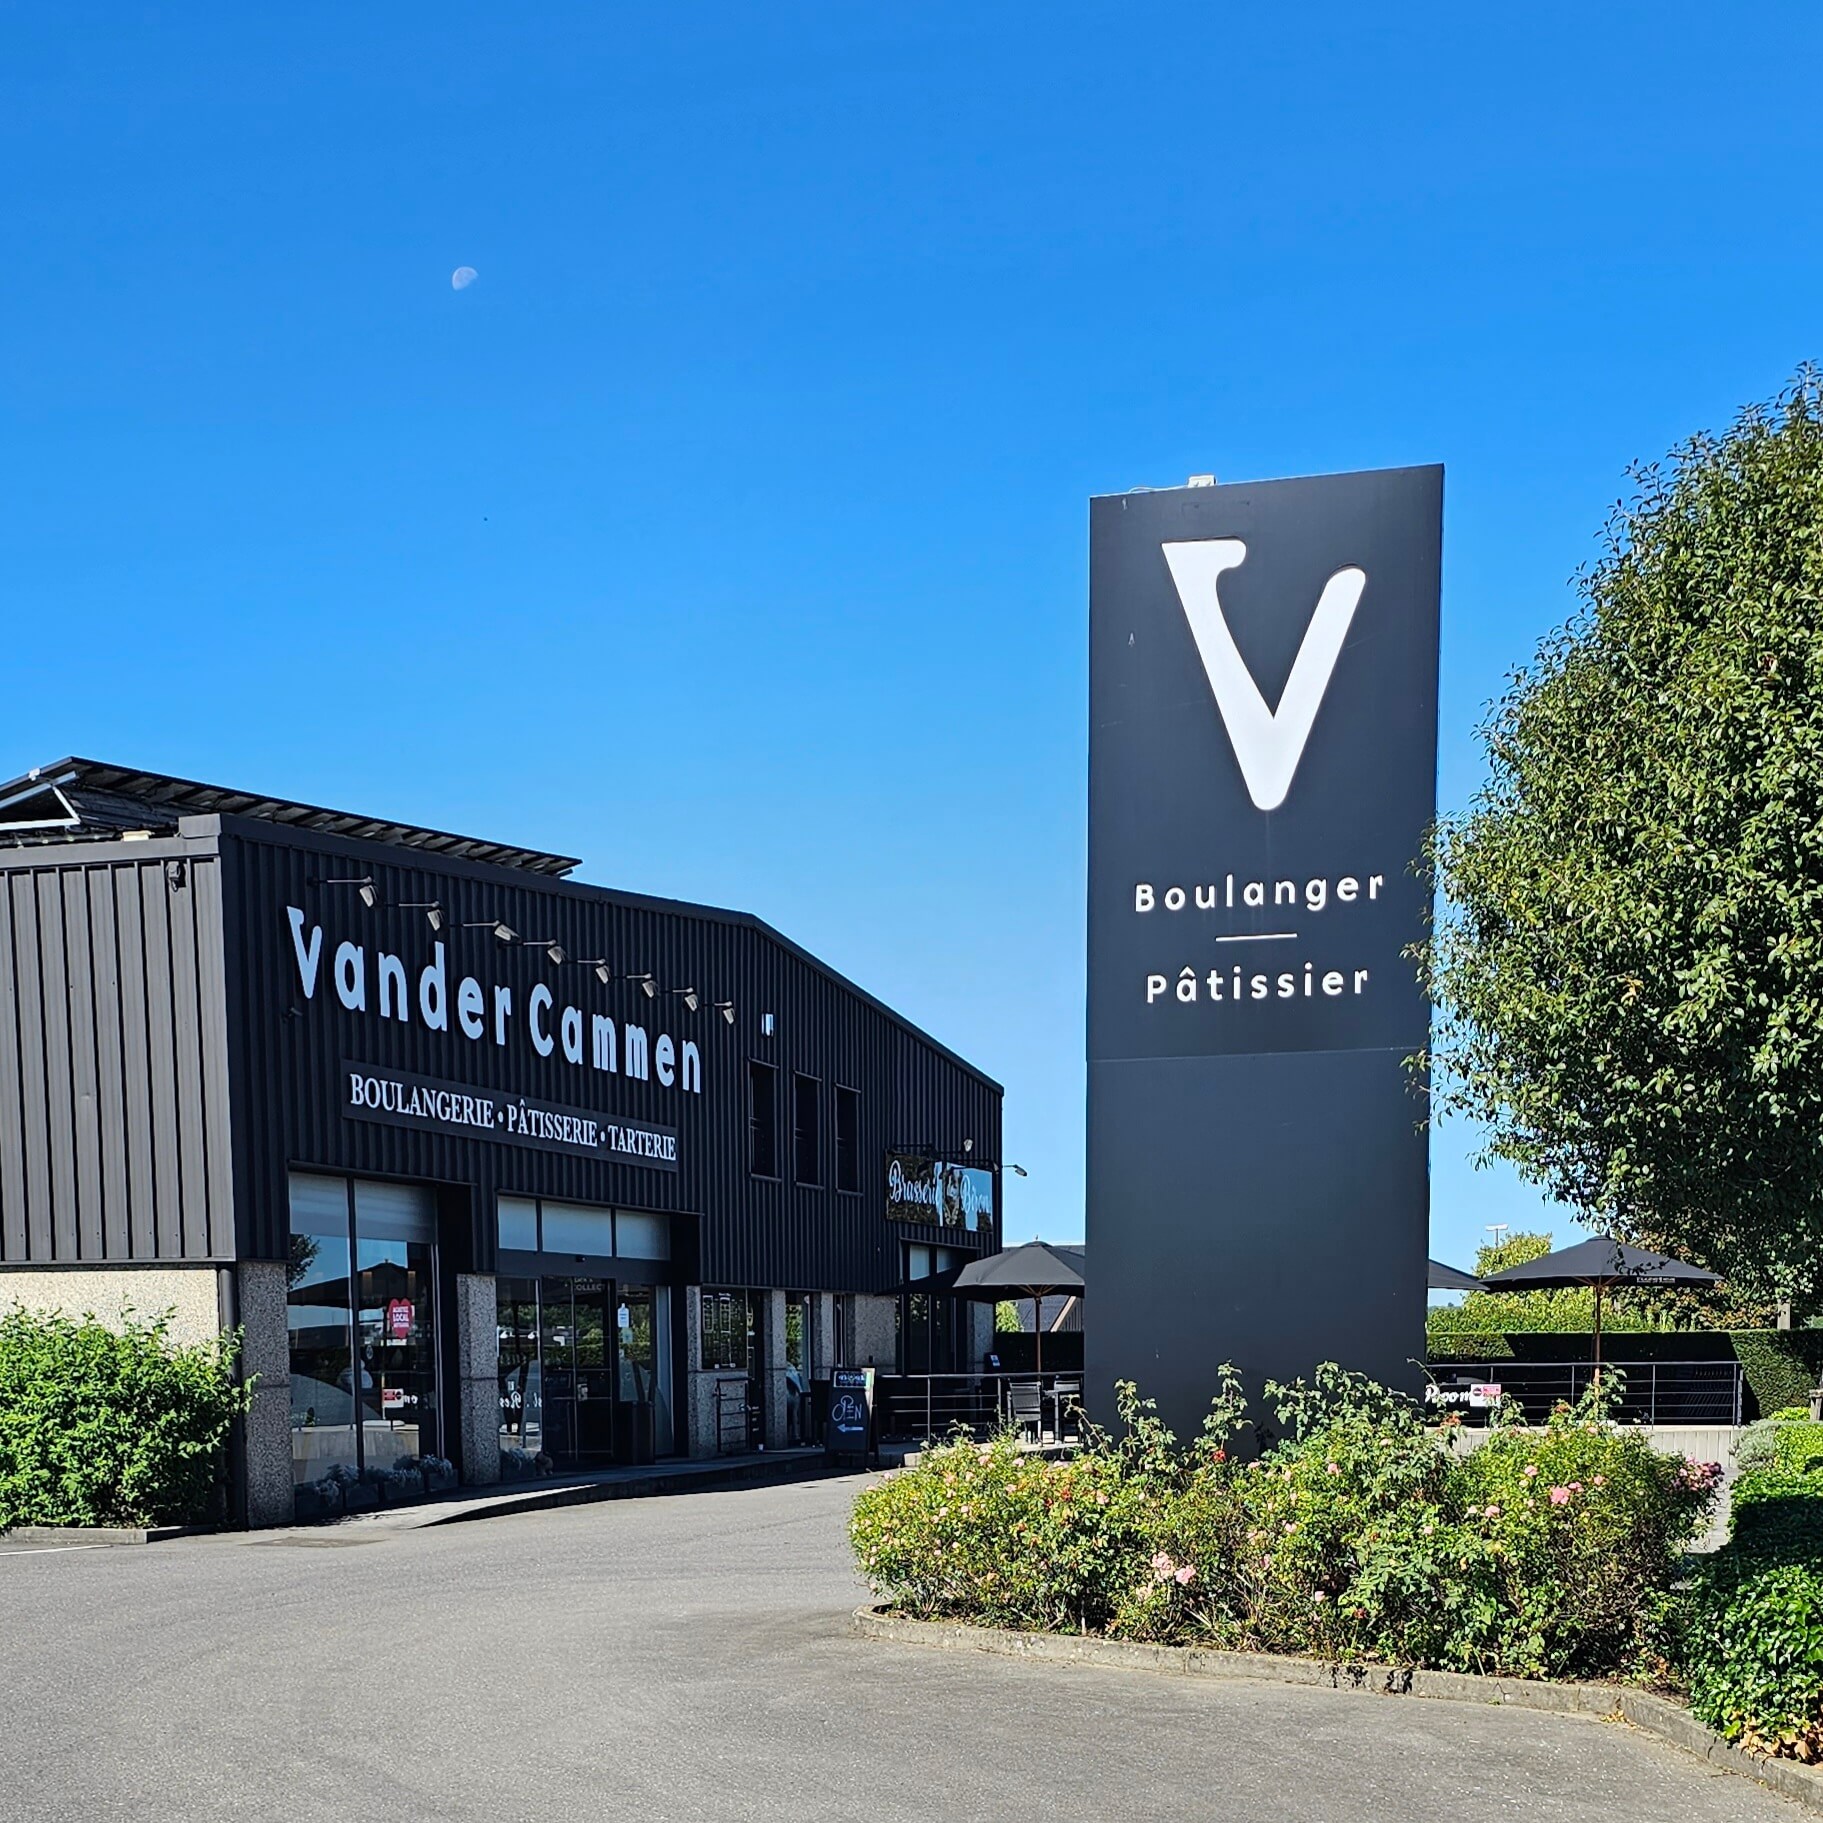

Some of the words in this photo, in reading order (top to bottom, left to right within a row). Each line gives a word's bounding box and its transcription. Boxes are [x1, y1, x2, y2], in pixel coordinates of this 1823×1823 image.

[1161, 538, 1367, 811] V
[1135, 873, 1385, 914] Boulanger
[1146, 962, 1370, 1005] Pâtissier
[349, 1072, 495, 1129] BOULANGERIE
[506, 1099, 599, 1148] PÂTISSERIE
[607, 1124, 677, 1162] TARTERIE
[831, 1394, 863, 1422] OPEN
